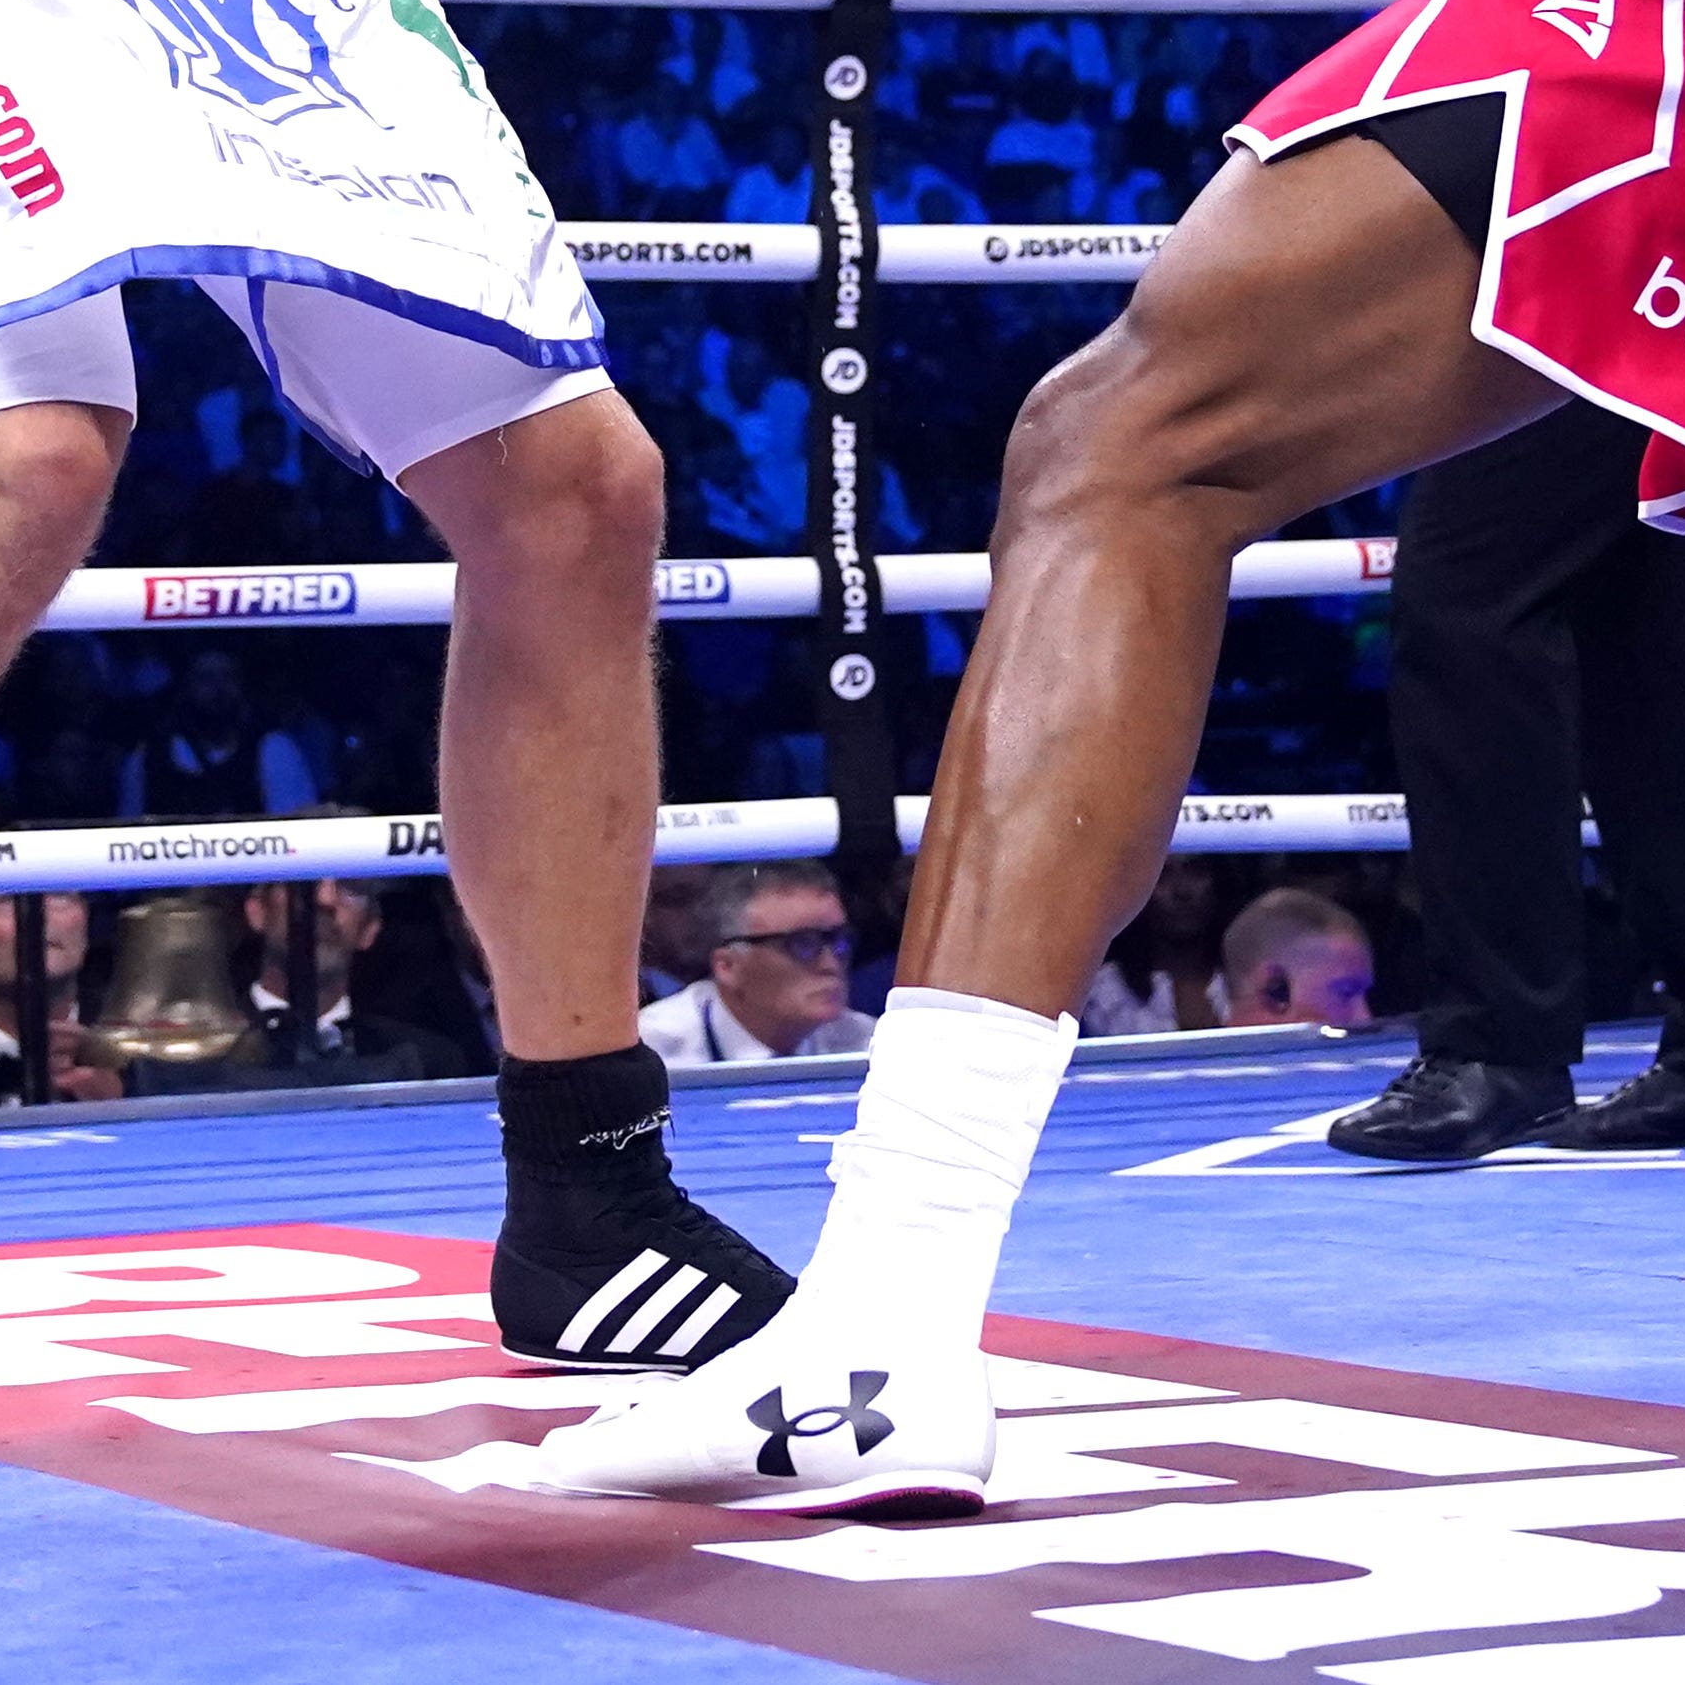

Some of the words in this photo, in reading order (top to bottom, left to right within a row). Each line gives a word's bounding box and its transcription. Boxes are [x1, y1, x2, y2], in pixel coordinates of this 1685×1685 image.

[828, 118, 864, 330] JDSPORTS.COM
[154, 575, 350, 617] BETFRED
[831, 414, 868, 635] JDSPORTS.COM
